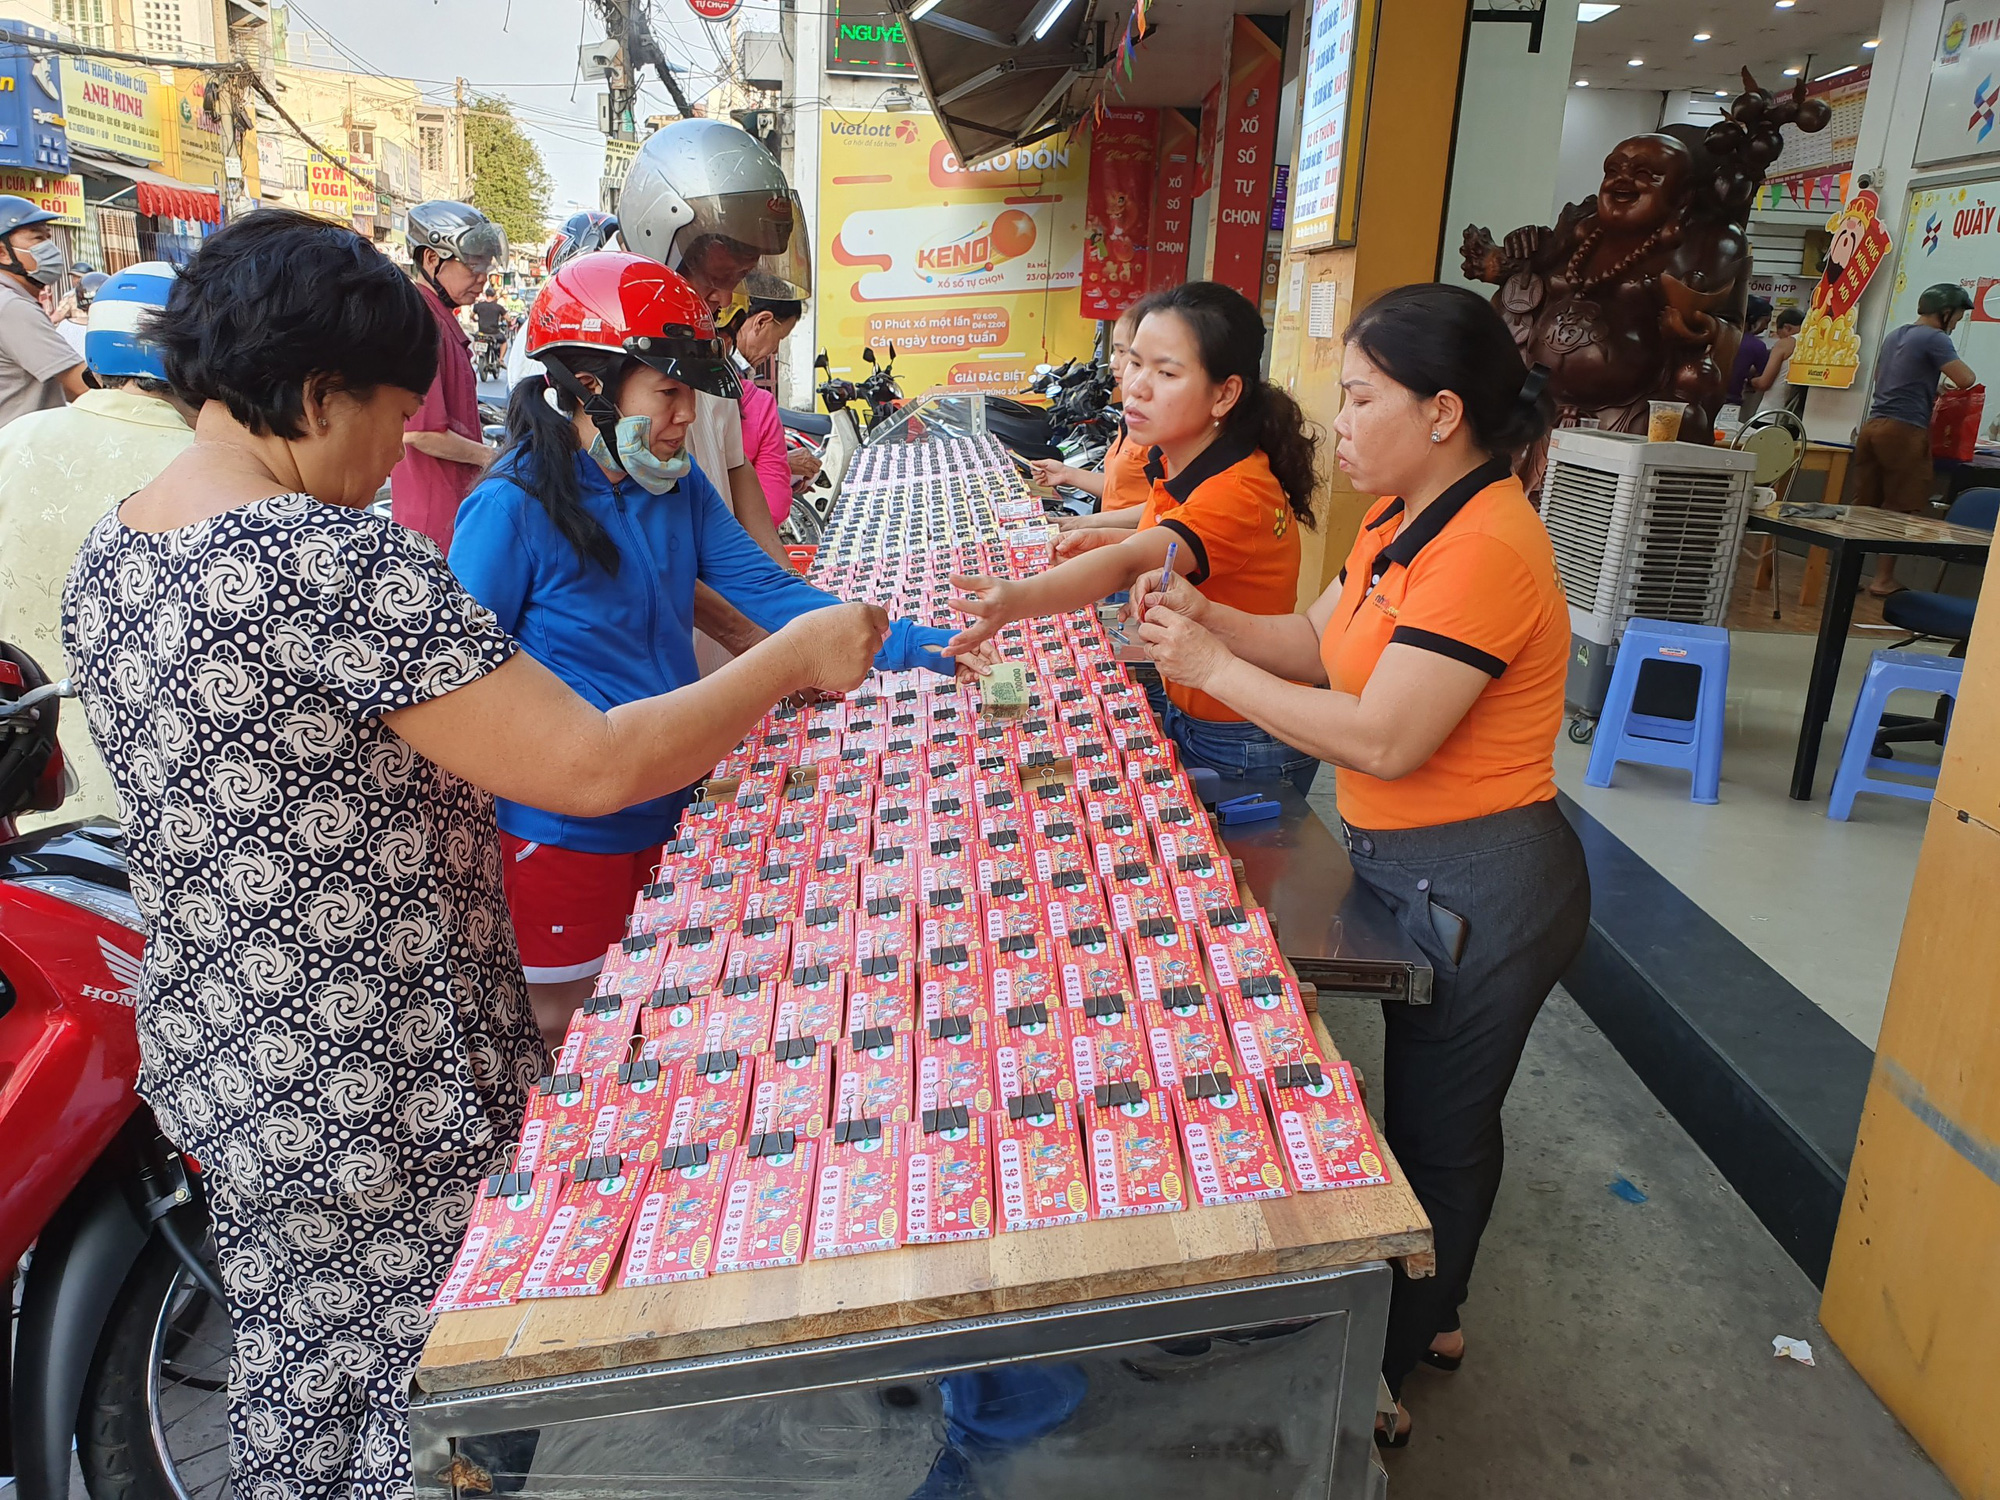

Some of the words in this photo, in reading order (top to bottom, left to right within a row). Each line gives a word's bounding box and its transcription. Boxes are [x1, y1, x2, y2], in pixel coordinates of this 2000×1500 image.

[83, 80, 110, 107] ANH
[112, 90, 144, 118] MINH
[830, 120, 892, 138] Vietlott
[1240, 115, 1260, 134] XỔ
[1237, 146, 1257, 164] SỐ
[312, 166, 345, 181] GYM
[53, 178, 80, 196] MINH
[311, 182, 348, 198] YOGA
[1235, 179, 1256, 197] TỰ
[41, 196, 68, 214] GỐI
[312, 199, 348, 217] 99K
[1167, 198, 1180, 210] SỐ
[1165, 220, 1180, 233] TỰ
[1222, 208, 1261, 227] CHỌN
[1952, 198, 1996, 240] QUẦY
[917, 235, 991, 269] KENO
[1156, 242, 1184, 254] CHỌN
[1864, 235, 1880, 262] CHÚC
[978, 273, 1004, 288] CHỌN
[1749, 280, 1772, 292] ỔNG
[1846, 266, 1860, 291] NĂM
[870, 320, 882, 330] 10
[884, 318, 911, 329] Phút
[929, 318, 952, 330] một
[896, 335, 927, 348] ngày
[930, 334, 965, 347] trong
[968, 330, 997, 343] tuần
[954, 371, 976, 384] GIẢI
[978, 371, 1000, 385] ĐẶC
[1002, 370, 1026, 384] BIỆT
[80, 984, 138, 1008] HON
